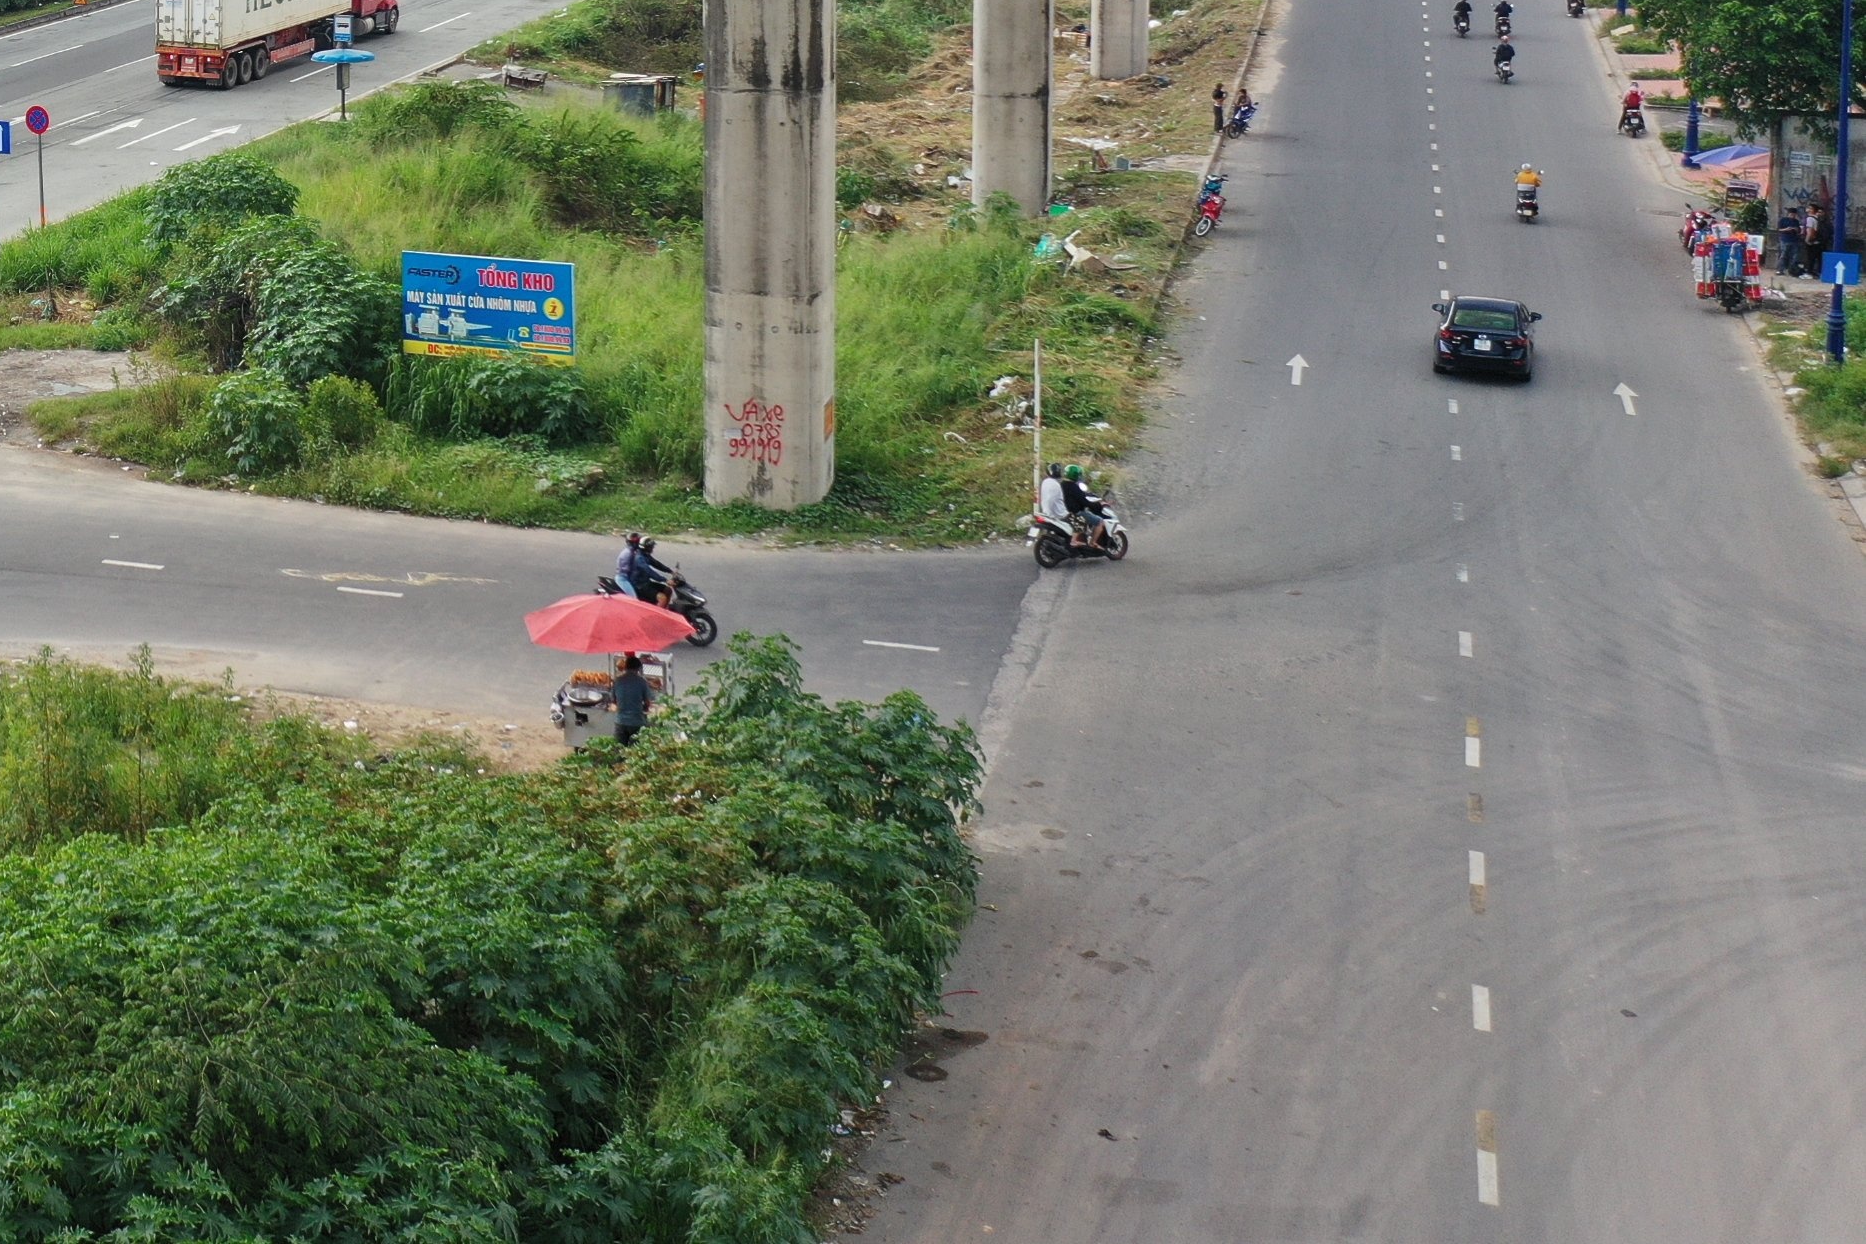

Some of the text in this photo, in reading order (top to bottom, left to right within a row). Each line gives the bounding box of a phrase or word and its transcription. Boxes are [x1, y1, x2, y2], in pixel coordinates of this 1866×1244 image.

[407, 267, 455, 279] FASTER
[476, 263, 555, 292] TỔNG KHO
[406, 288, 537, 315] MÁY SẢN XUẤT CỬA NHÔM NHỰA
